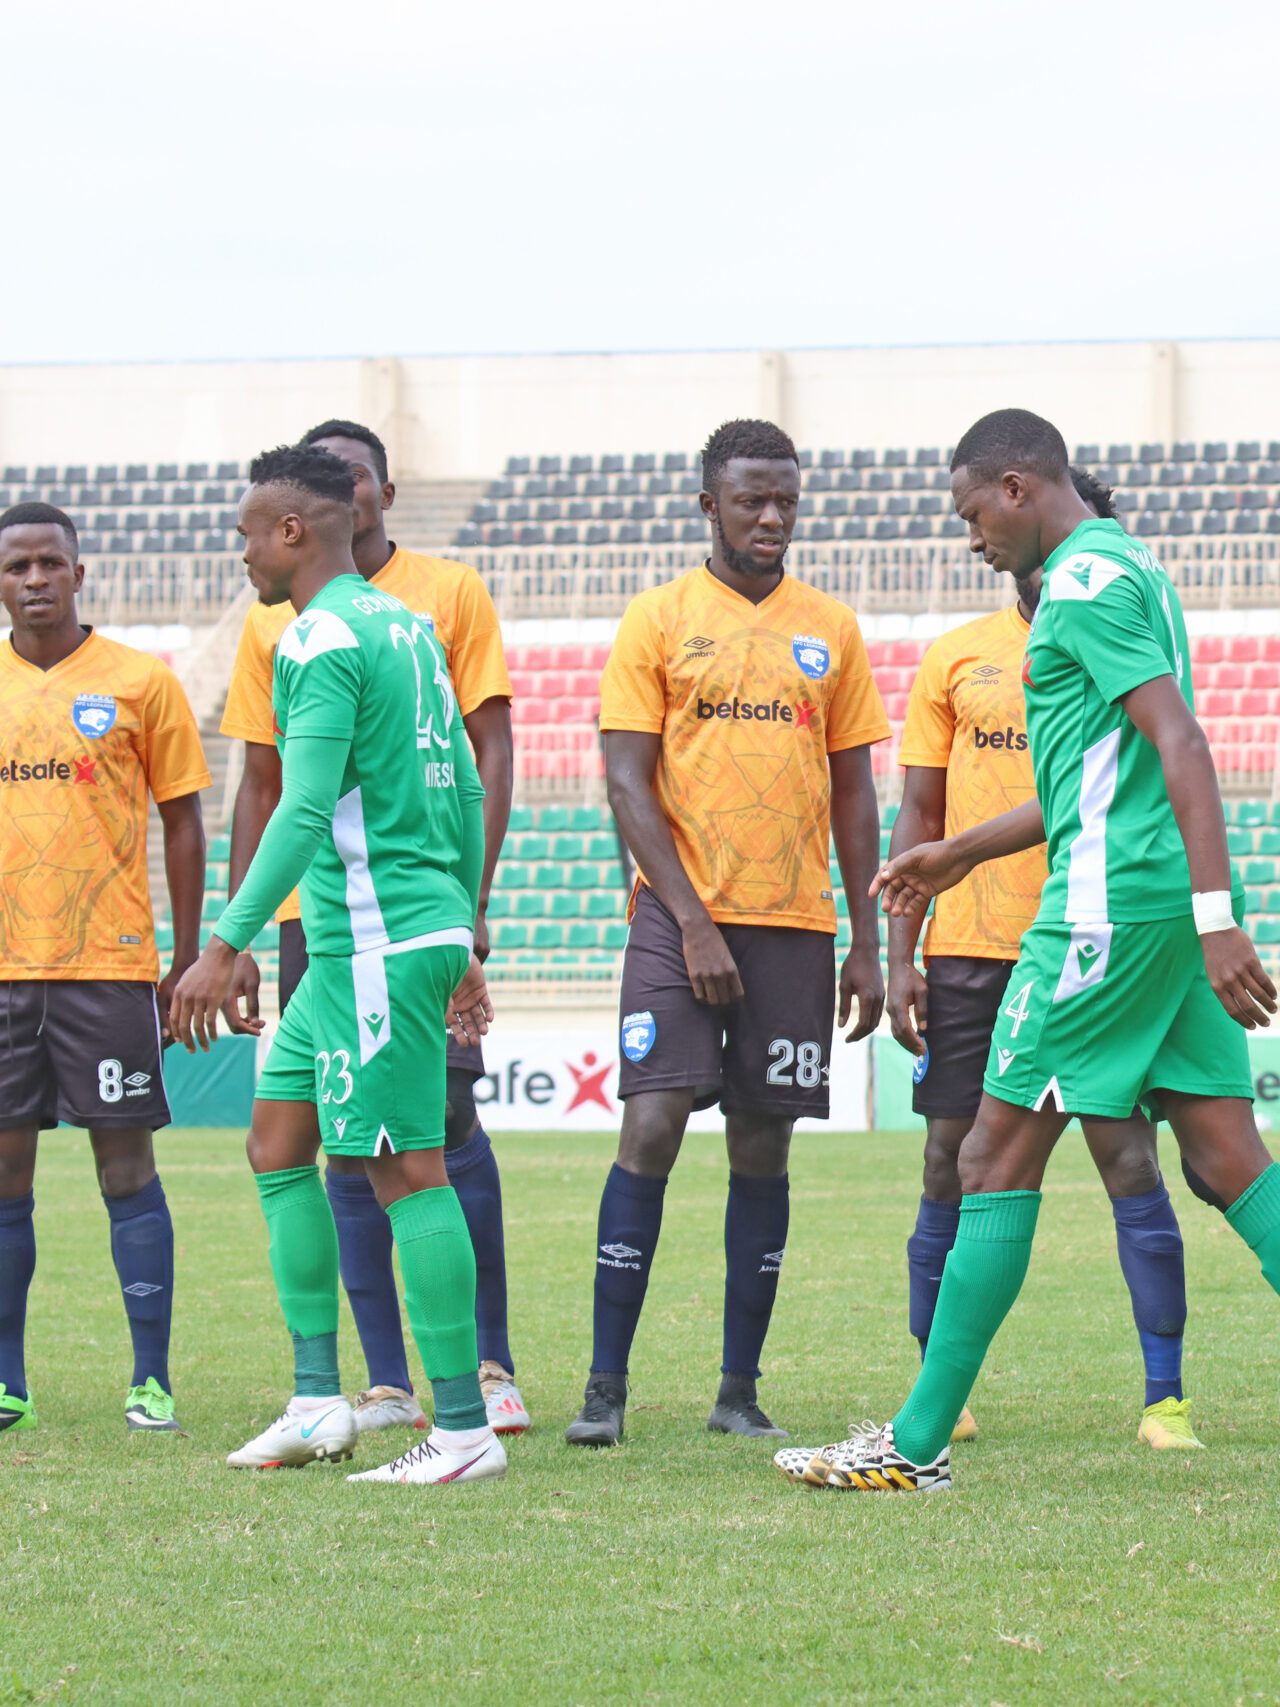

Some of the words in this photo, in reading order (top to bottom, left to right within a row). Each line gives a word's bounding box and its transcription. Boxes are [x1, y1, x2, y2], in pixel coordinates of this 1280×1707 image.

[686, 650, 715, 659] umbro
[697, 697, 793, 722] betsafe
[1004, 981, 1034, 1038] 4
[98, 1058, 123, 1103] 8
[316, 1049, 353, 1104] 23
[766, 1038, 822, 1088] 28
